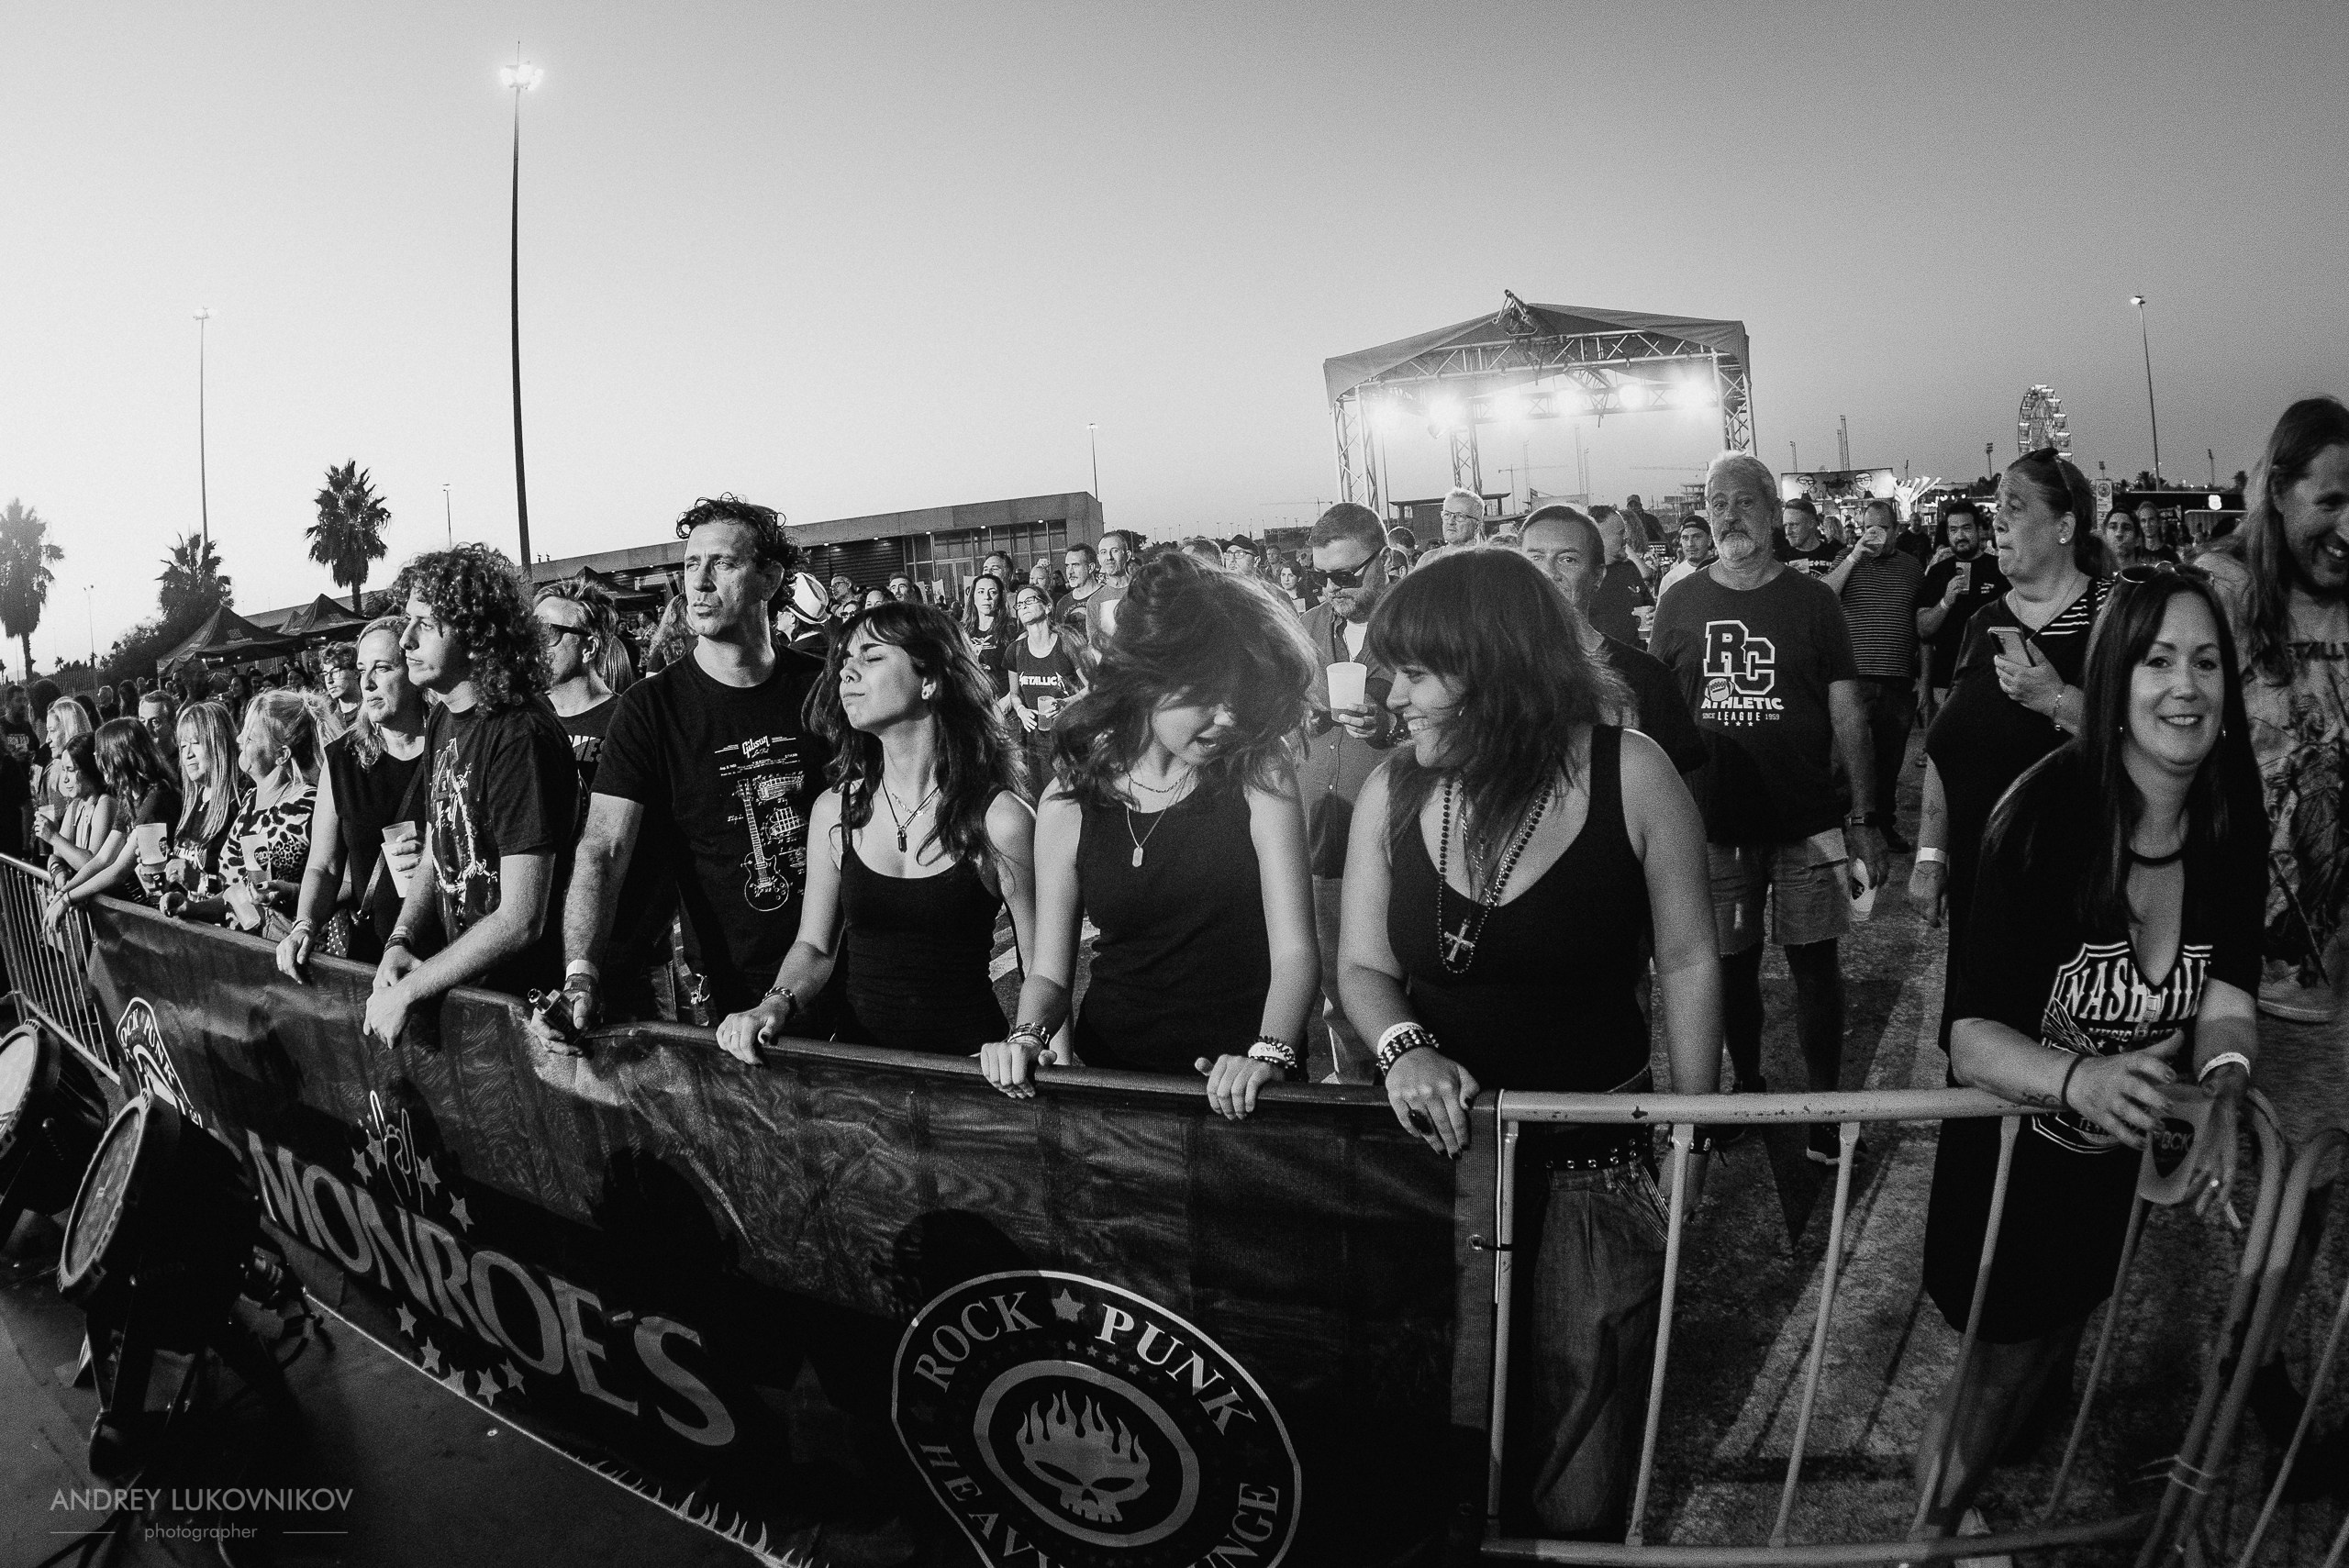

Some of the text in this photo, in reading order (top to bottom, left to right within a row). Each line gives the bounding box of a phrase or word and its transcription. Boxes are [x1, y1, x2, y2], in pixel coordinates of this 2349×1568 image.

[1703, 620, 1776, 695] RC
[1718, 711, 1761, 721] LEAGUE
[742, 735, 771, 759] Gibson
[914, 1291, 1257, 1436] ROCK PUNK
